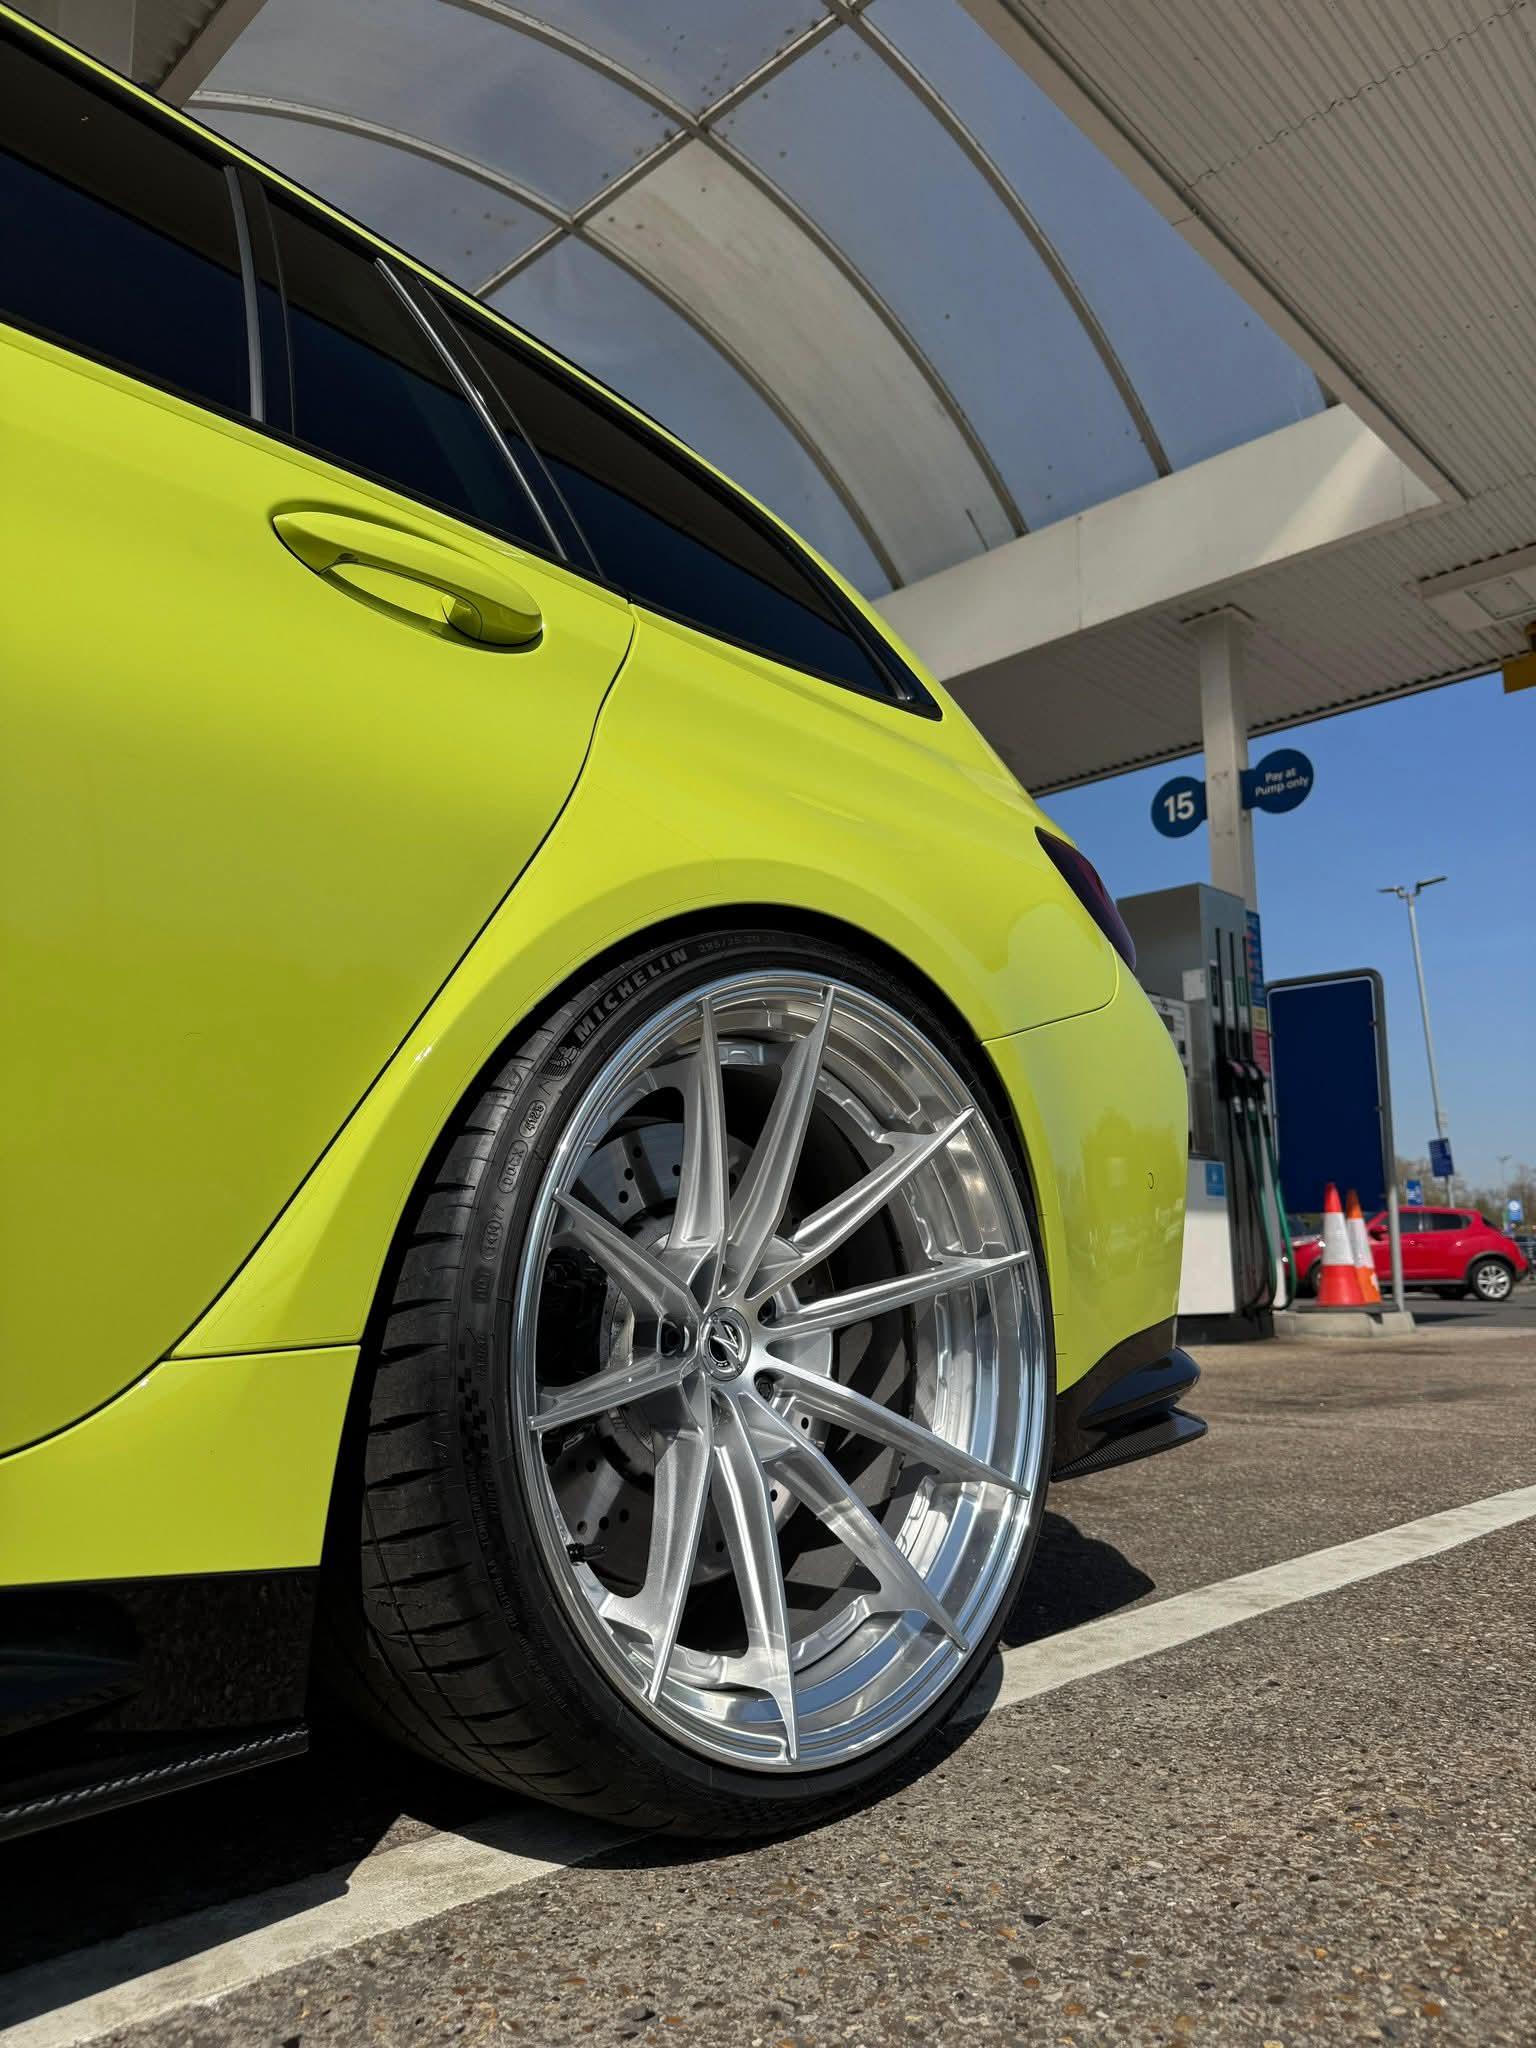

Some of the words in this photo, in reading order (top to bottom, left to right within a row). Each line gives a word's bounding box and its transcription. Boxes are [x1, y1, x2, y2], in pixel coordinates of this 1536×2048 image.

[1255, 781, 1285, 797] Pump
[1286, 776, 1310, 790] only
[1265, 770, 1283, 783] Pay
[1285, 768, 1296, 778] at
[1163, 791, 1195, 823] 15
[573, 948, 689, 1043] MICHELIN
